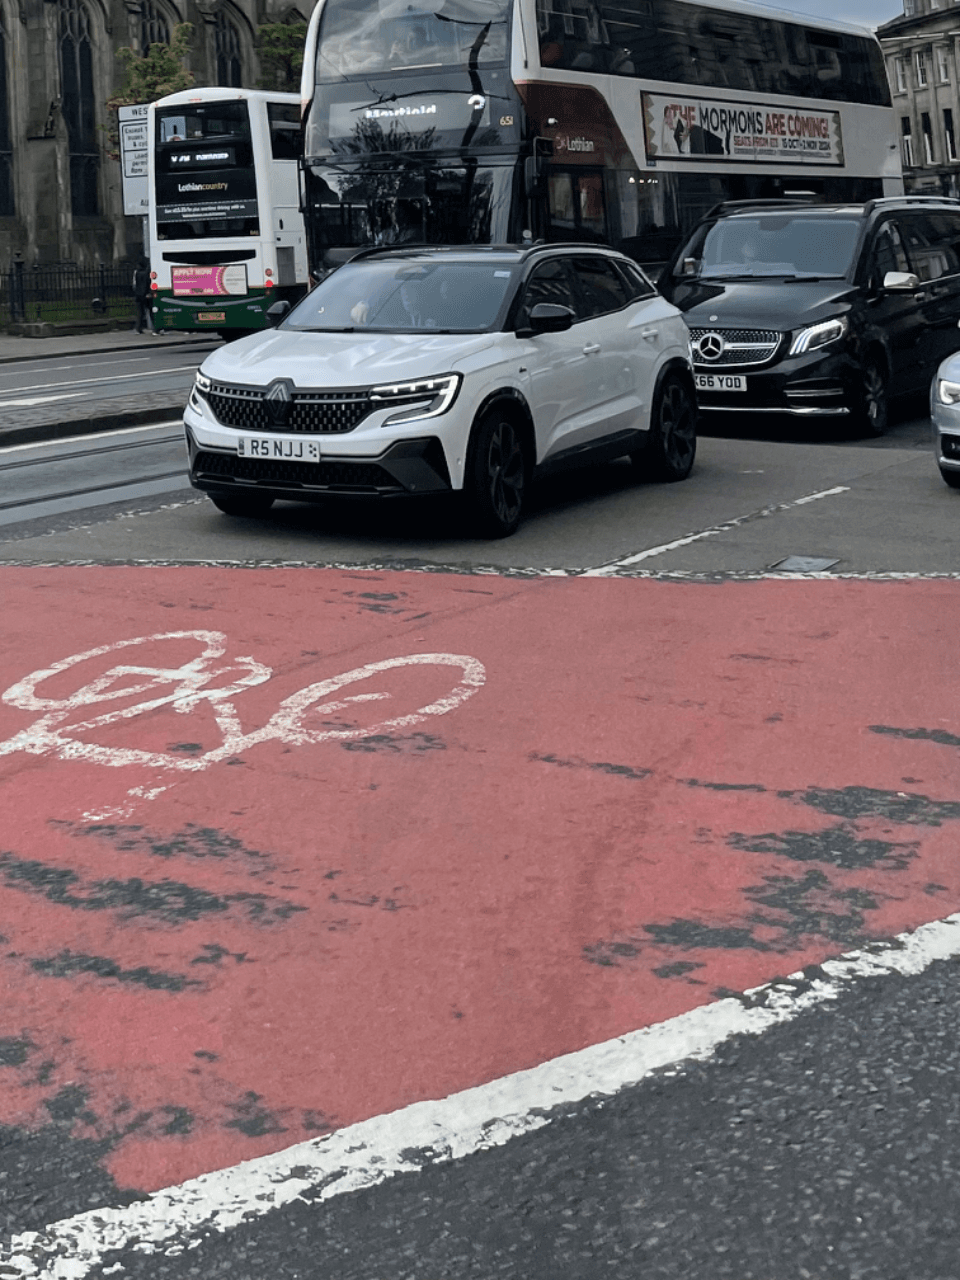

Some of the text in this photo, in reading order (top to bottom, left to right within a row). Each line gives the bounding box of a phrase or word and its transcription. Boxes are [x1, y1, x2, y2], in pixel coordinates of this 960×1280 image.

[131, 107, 148, 117] WES
[699, 105, 763, 135] MORMONS
[765, 113, 787, 136] ARE
[788, 114, 830, 138] COMING!
[718, 376, 741, 388] YOD
[251, 439, 302, 458] R5 NJJ
